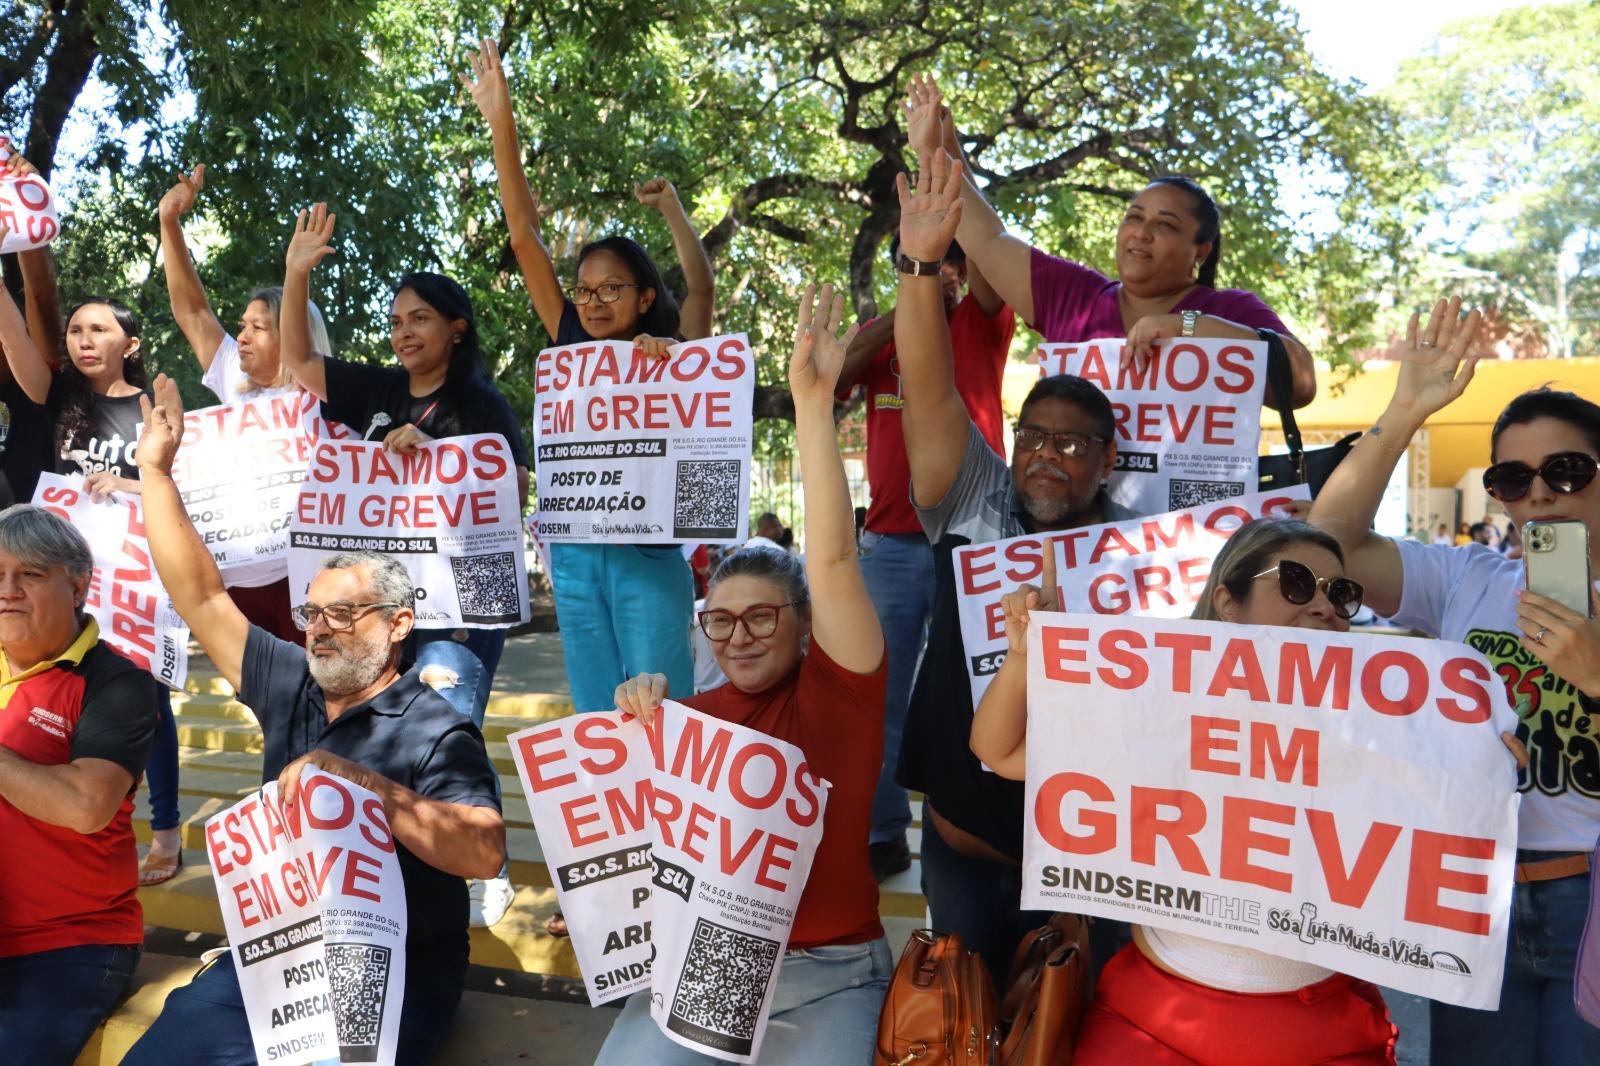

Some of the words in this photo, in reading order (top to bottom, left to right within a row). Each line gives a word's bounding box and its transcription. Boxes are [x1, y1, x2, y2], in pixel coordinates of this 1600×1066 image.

[536, 339, 746, 395] ESTAMOS
[1038, 344, 1256, 394] STAMOS
[541, 400, 574, 436] EM
[587, 392, 732, 432] GREVE
[1112, 403, 1237, 446] REVE
[304, 439, 507, 486] STAMOS
[555, 446, 569, 457] RIO
[570, 444, 614, 456] GRANDE
[616, 444, 634, 454] DO
[635, 441, 662, 454] SUL
[1128, 455, 1154, 470] SUL
[551, 472, 597, 487] POSTO
[600, 470, 623, 485] DE
[298, 491, 346, 525] EM
[359, 491, 500, 528] GREVE
[295, 537, 319, 547] S.O.S.
[321, 538, 338, 548] RIO
[340, 539, 386, 550] GRANDE
[388, 540, 407, 551] DO
[409, 540, 433, 551] SUL
[1088, 557, 1212, 616] GRE
[1041, 626, 1493, 725] ESTAMOS
[1555, 702, 1592, 735] de
[1190, 715, 1320, 787] EM
[559, 778, 653, 849] EM
[652, 788, 799, 893] REVE
[1034, 771, 1496, 937] GREVE
[567, 858, 623, 884] S.O.S.
[659, 868, 690, 895] SUL
[232, 872, 282, 928] EM
[698, 891, 715, 904] Chave
[717, 899, 727, 908] PIX
[700, 881, 711, 892] PIX
[712, 886, 734, 901] S.O.S.
[735, 894, 749, 905] RIO
[750, 899, 776, 913] GRANDE
[776, 906, 785, 916] DO
[720, 910, 751, 926] Instituição
[1039, 890, 1076, 899] SINDICATO
[1077, 893, 1092, 902] DOS
[1093, 896, 1141, 910] SERVIDORES
[1137, 904, 1171, 918] PÚBLICOS
[1172, 913, 1212, 926] MUNICIPAIS
[1224, 923, 1260, 936] TERESINA
[327, 909, 338, 917] RIO
[340, 909, 374, 920] GRANDE
[375, 914, 387, 924] DO
[387, 918, 401, 930] SUL
[244, 938, 275, 962] S.O.S.
[275, 936, 289, 951] RIO
[288, 919, 322, 946] GRANDE
[283, 959, 325, 989] POSTO
[270, 992, 335, 1029] ARRECA
